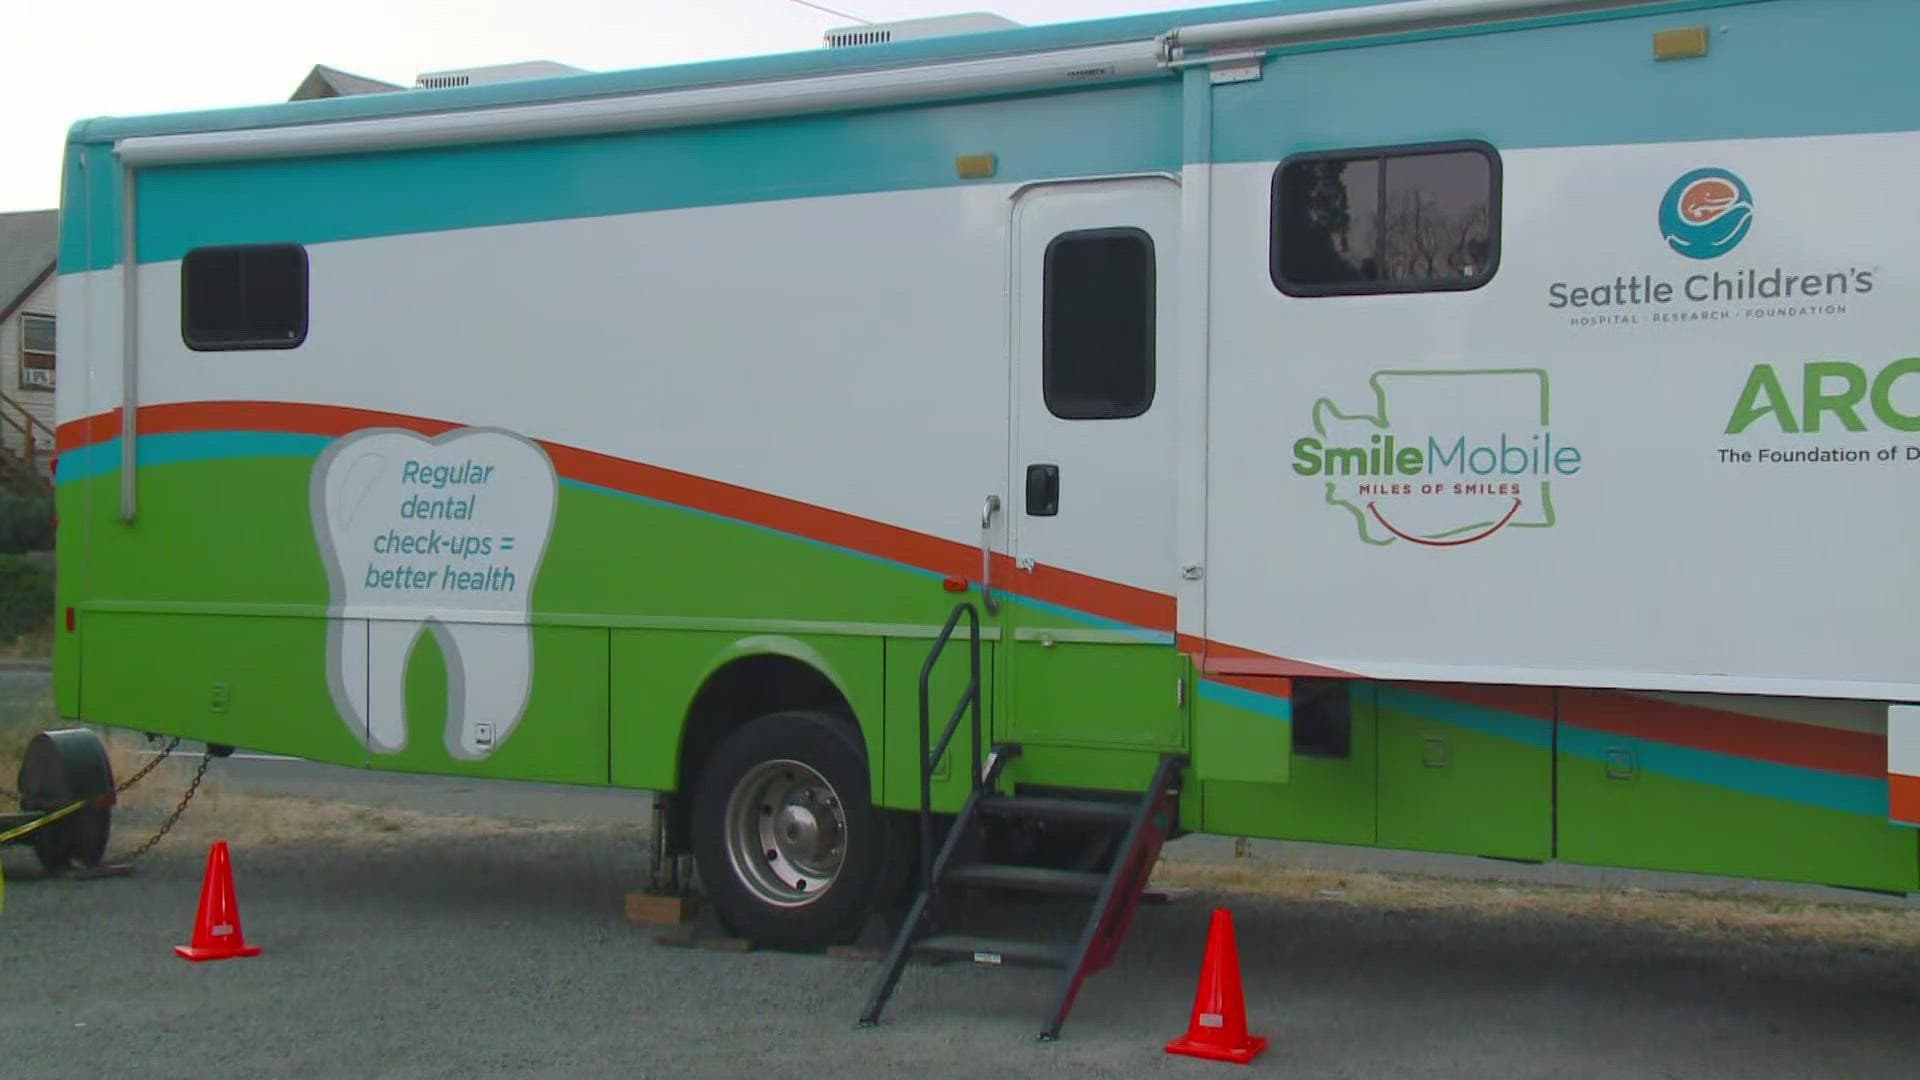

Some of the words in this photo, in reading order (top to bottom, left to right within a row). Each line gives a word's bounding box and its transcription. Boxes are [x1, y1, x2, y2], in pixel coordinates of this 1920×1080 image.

[1549, 275, 1674, 309] Seattle
[1684, 267, 1874, 302] Children's
[1570, 315, 1639, 327] HOSPITAL
[1652, 310, 1730, 323] RESEARCH
[1745, 304, 1848, 320] FOUNDATION
[1292, 432, 1582, 476] SmileMobile
[1718, 449, 1752, 463] The
[1758, 446, 1870, 463] Foundation
[1877, 446, 1897, 461] of
[402, 460, 494, 489] Regular
[1359, 483, 1412, 496] MILES
[1421, 483, 1444, 495] OF
[1453, 483, 1521, 495] SMILES
[400, 495, 476, 521] dental
[374, 529, 493, 559] check-ups
[364, 564, 437, 590] better
[442, 565, 516, 592] health
